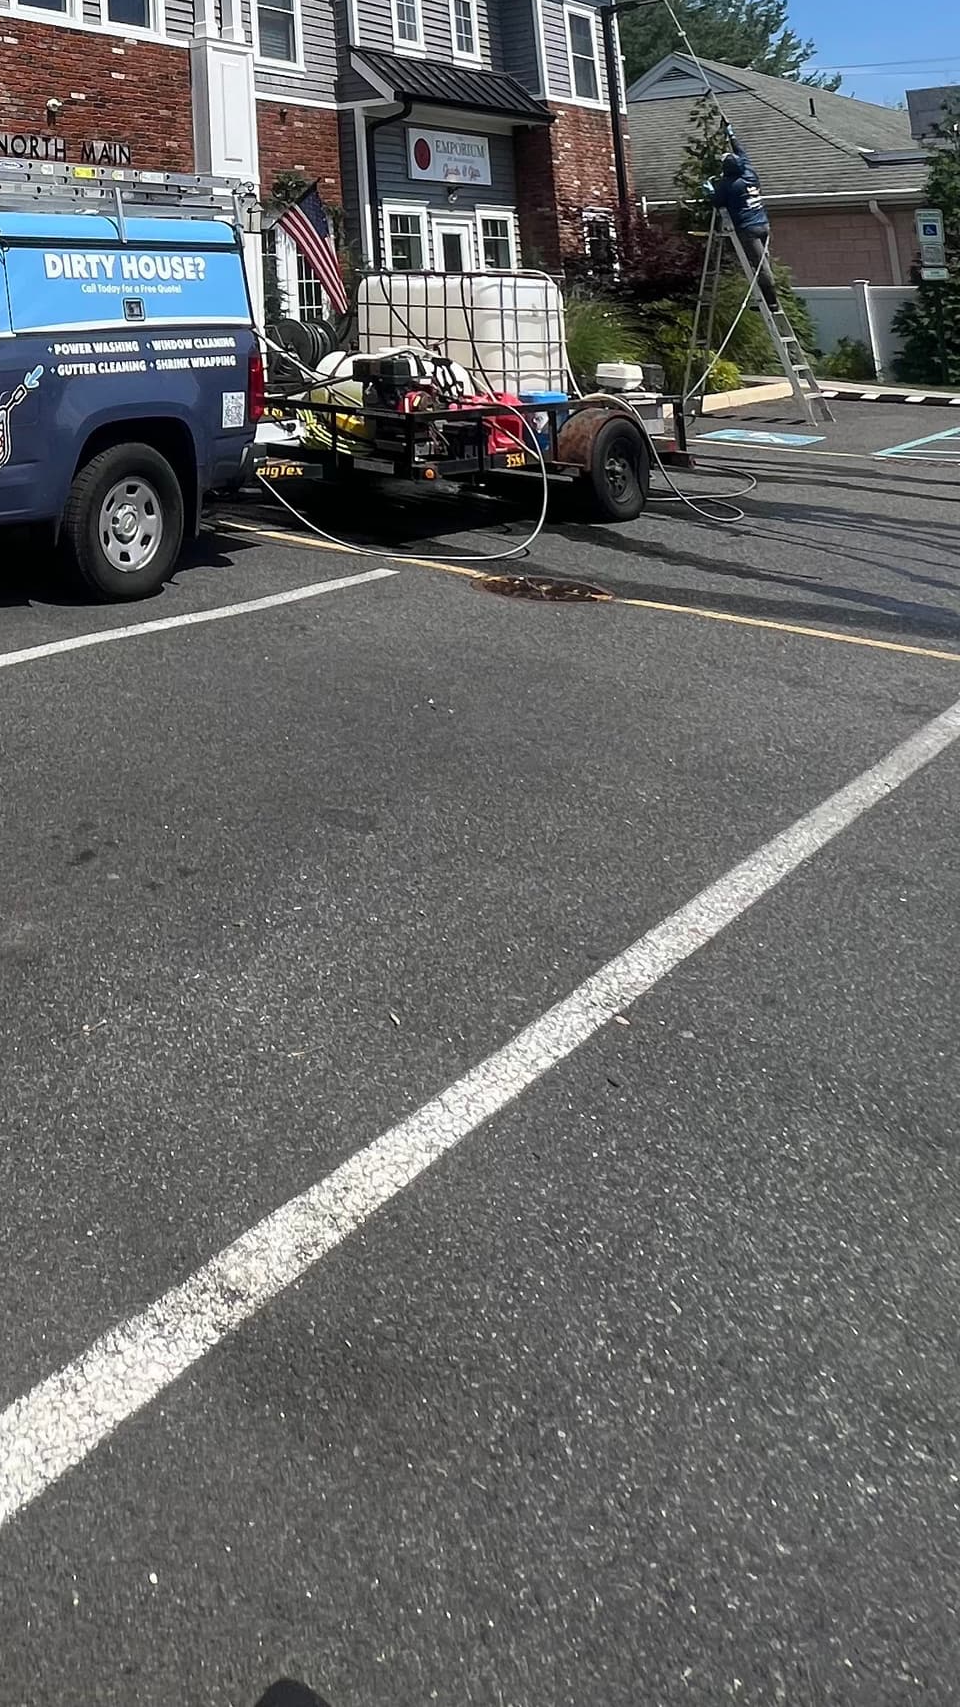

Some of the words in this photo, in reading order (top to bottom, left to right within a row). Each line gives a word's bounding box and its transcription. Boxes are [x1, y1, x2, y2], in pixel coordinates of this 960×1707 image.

[80, 140, 132, 166] MAIN
[434, 139, 486, 159] EMPORIUM
[44, 253, 116, 279] DIRTY
[120, 254, 206, 281] HOUSE?
[81, 283, 97, 294] Call
[97, 283, 120, 295] Today
[121, 283, 133, 294] for
[140, 284, 156, 294] Free
[54, 342, 93, 355] POWER
[93, 340, 140, 354] WASHING
[151, 338, 193, 351] WINDOW
[193, 336, 236, 349] CLEANING
[57, 362, 98, 376] GUTTER
[98, 359, 147, 374] CLEANING
[155, 358, 191, 371] SHRINK
[190, 355, 237, 369] WRAPPING
